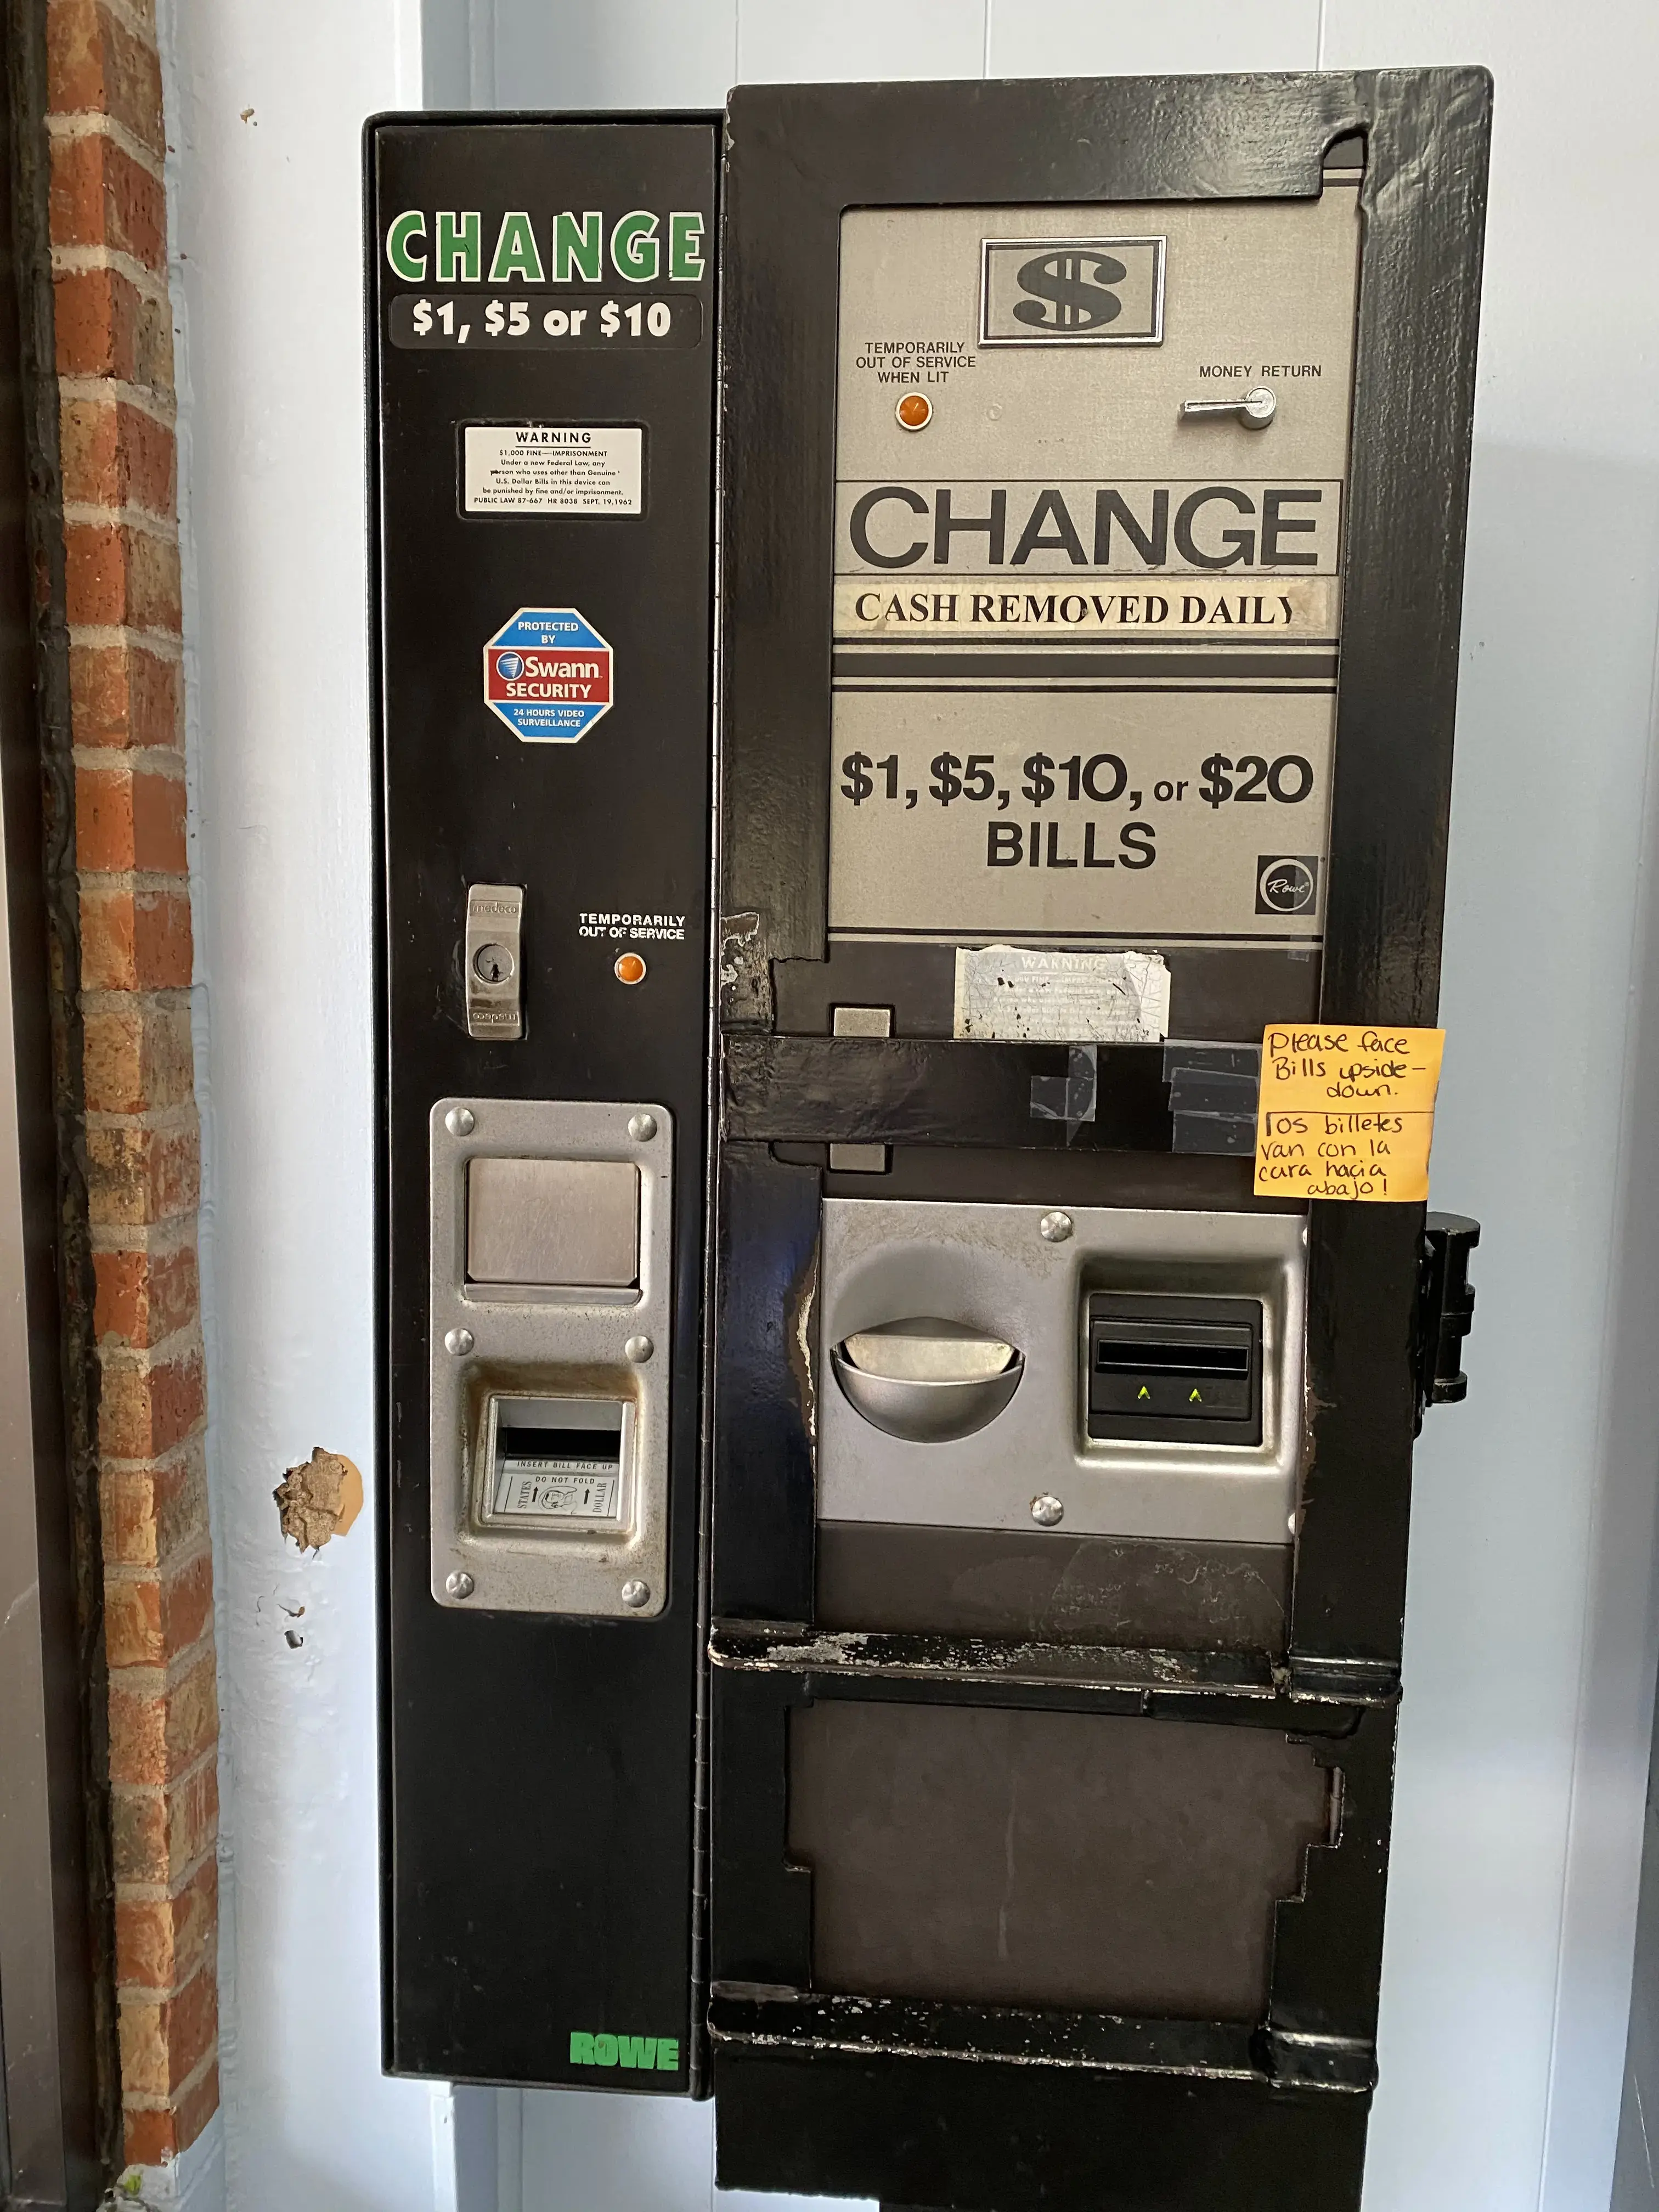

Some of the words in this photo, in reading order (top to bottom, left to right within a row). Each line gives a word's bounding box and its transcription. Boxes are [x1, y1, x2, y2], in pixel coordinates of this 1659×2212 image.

[386, 210, 706, 283] CHANGE
[413, 298, 471, 343] $1,
[484, 299, 530, 337] $5
[543, 308, 588, 336] or
[600, 300, 672, 338] $10
[865, 342, 965, 354] TEMPORARILY
[856, 357, 885, 368] OUT
[891, 357, 911, 368] OF
[916, 356, 975, 368] SERVICE
[1199, 365, 1252, 378] MONEY
[1261, 364, 1322, 377] RETURN
[877, 371, 919, 383] WHEN
[927, 371, 949, 382] LIT
[516, 432, 591, 443] WARNING
[849, 486, 1322, 569] CHANGE
[855, 592, 957, 623] CASH
[970, 594, 1169, 624] REMOVED
[518, 622, 579, 631] PROTECTED
[541, 635, 556, 644] BY
[506, 682, 592, 698] SECURITY
[517, 718, 581, 727] SURVEILLANCE
[527, 709, 555, 717] HOURS
[558, 709, 585, 718] VIDEO
[840, 752, 918, 810] $1,
[929, 752, 1010, 810] $5,
[1022, 752, 1142, 811] $10,
[1154, 777, 1189, 802] or
[1199, 753, 1313, 809] $20
[987, 821, 1157, 870] BILLS
[473, 901, 517, 914] medeco
[579, 912, 685, 928] TEMPORARILY
[579, 926, 605, 938] OUT
[608, 927, 627, 938] OF
[629, 927, 685, 940] SERVICE
[1357, 1030, 1410, 1054] face
[1272, 1057, 1326, 1080] Bills
[1327, 1082, 1398, 1098] down.
[1325, 1114, 1403, 1135] billetes
[1317, 1142, 1356, 1158] con
[1369, 1138, 1391, 1156] la
[1258, 1166, 1312, 1182] cara
[1325, 1160, 1387, 1177] hacia
[517, 1481, 532, 1509] STATES
[592, 1482, 607, 1513] DOLLAR
[569, 2032, 680, 2071] ROWE
